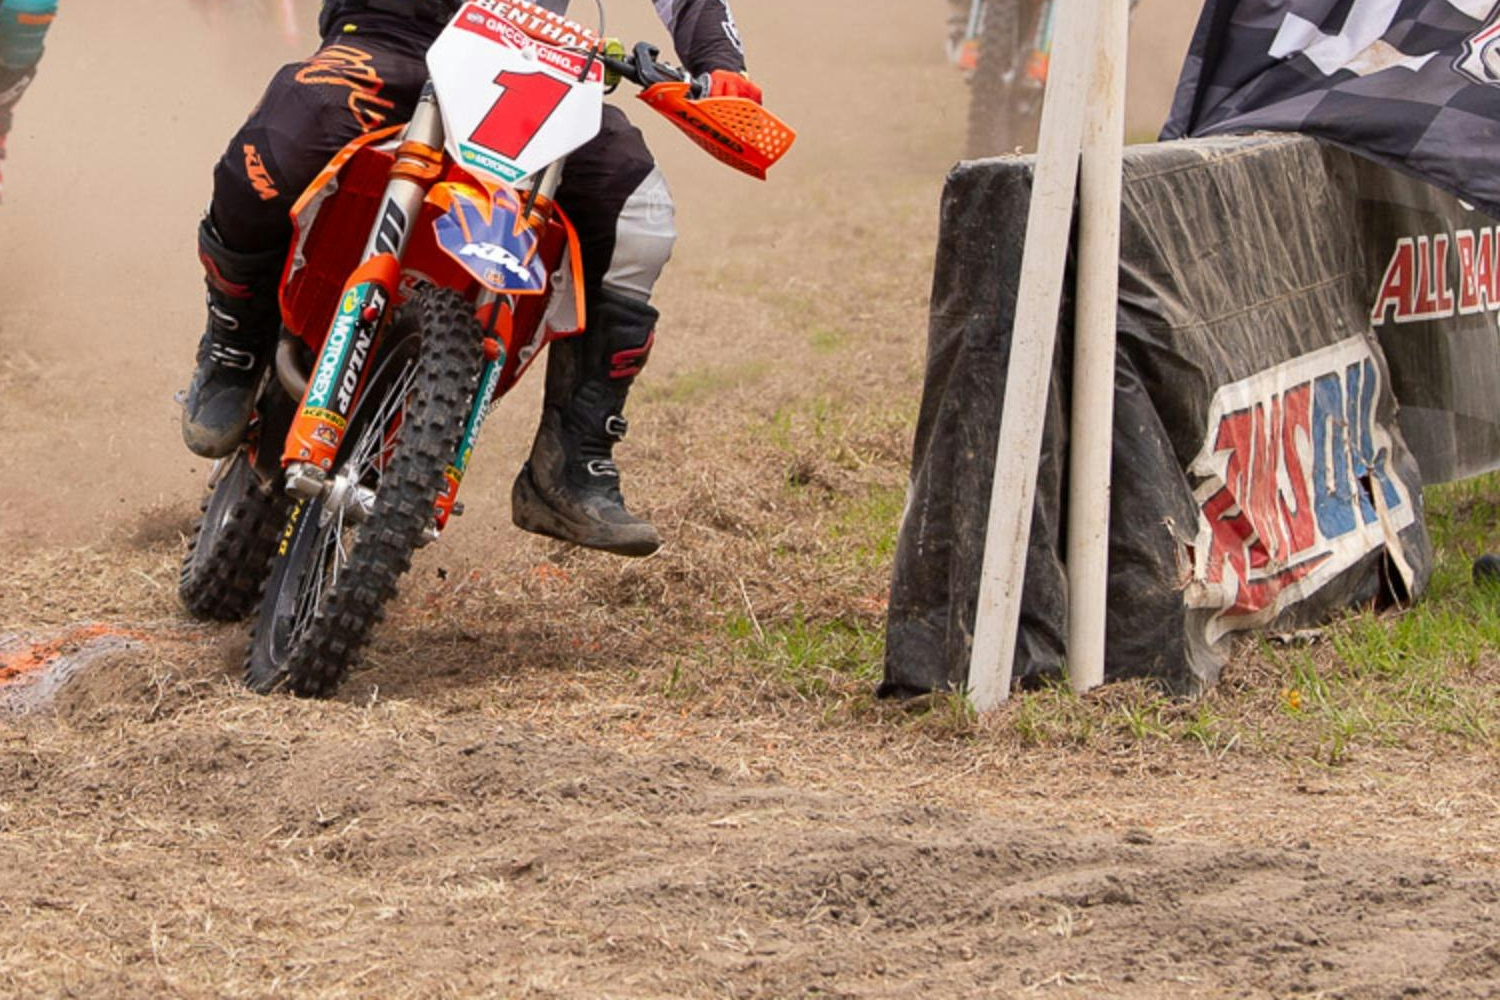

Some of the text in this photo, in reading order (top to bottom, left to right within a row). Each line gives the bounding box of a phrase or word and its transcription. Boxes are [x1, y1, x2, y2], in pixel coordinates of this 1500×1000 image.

[467, 69, 573, 161] 1
[243, 143, 279, 200] KTM
[459, 241, 531, 283] KTM
[1370, 225, 1500, 326] ALL BA
[308, 314, 354, 406] MOTOREX
[337, 288, 387, 415] DNLOP
[468, 359, 503, 448] MOTOREX
